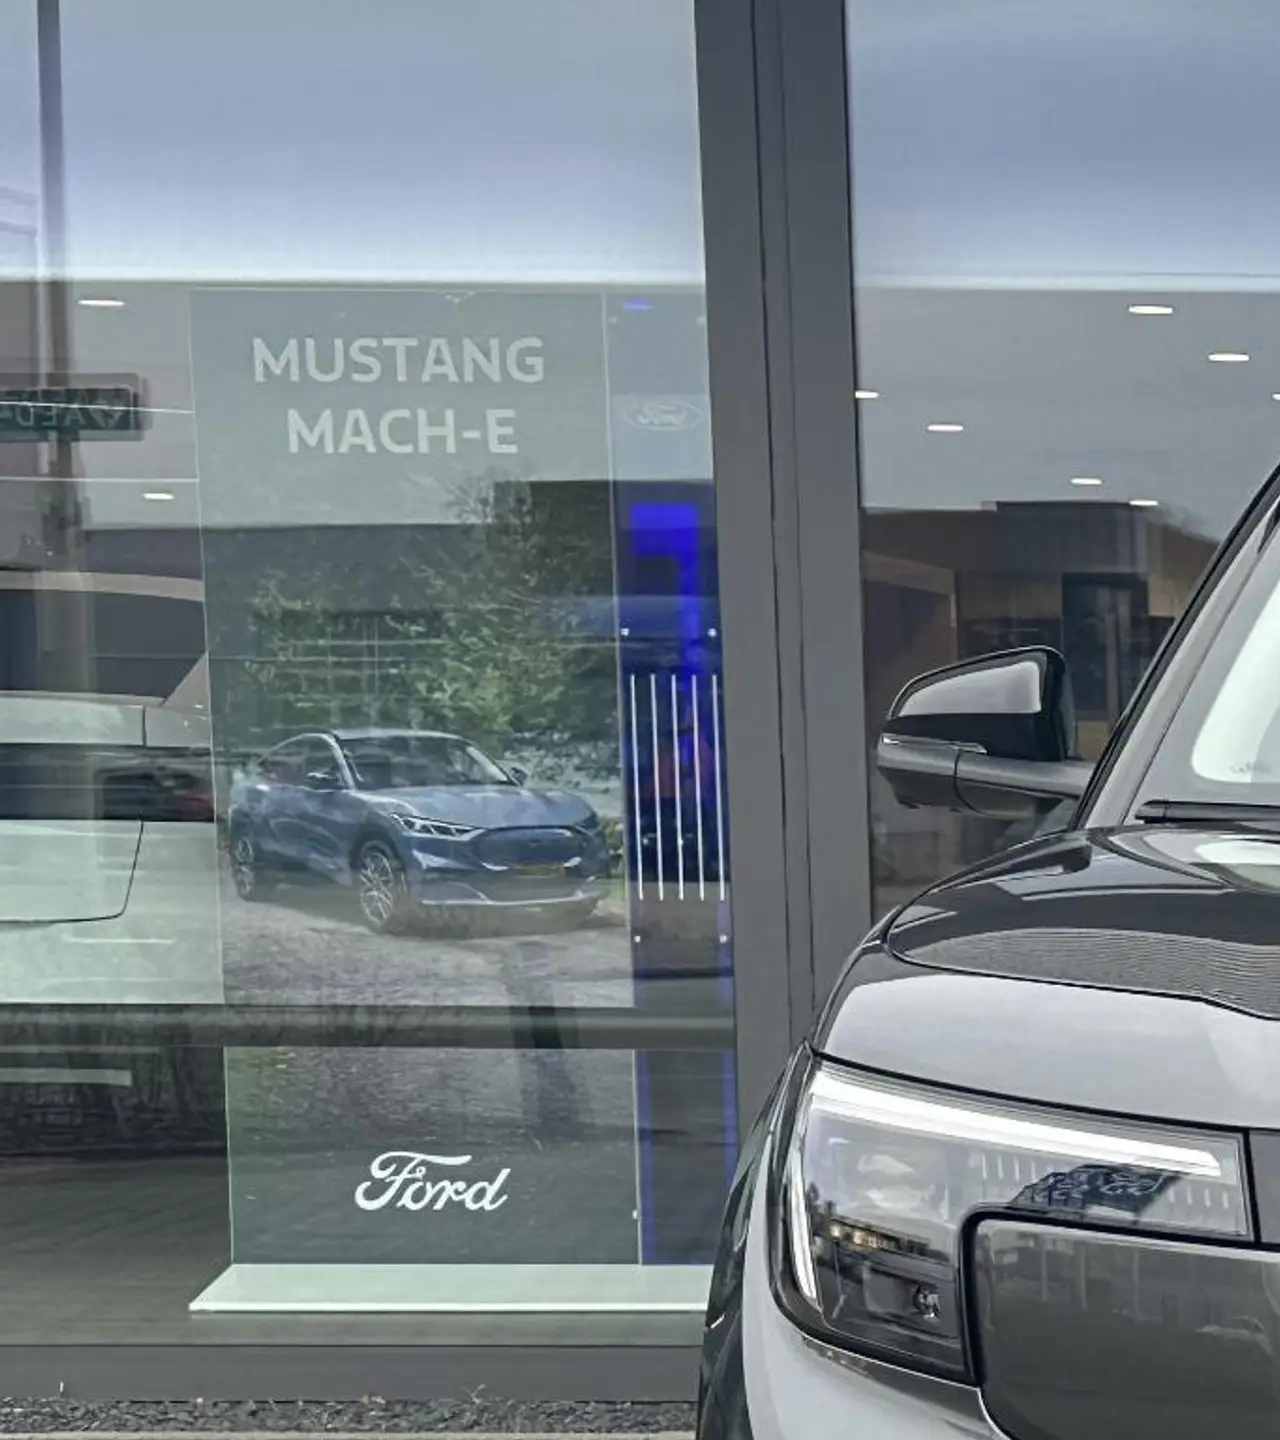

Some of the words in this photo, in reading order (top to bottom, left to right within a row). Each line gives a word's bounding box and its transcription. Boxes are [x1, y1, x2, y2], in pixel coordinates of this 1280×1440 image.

[252, 337, 545, 383] MUSTANG
[287, 408, 519, 454] MACH-E
[354, 1151, 512, 1211] Ford
